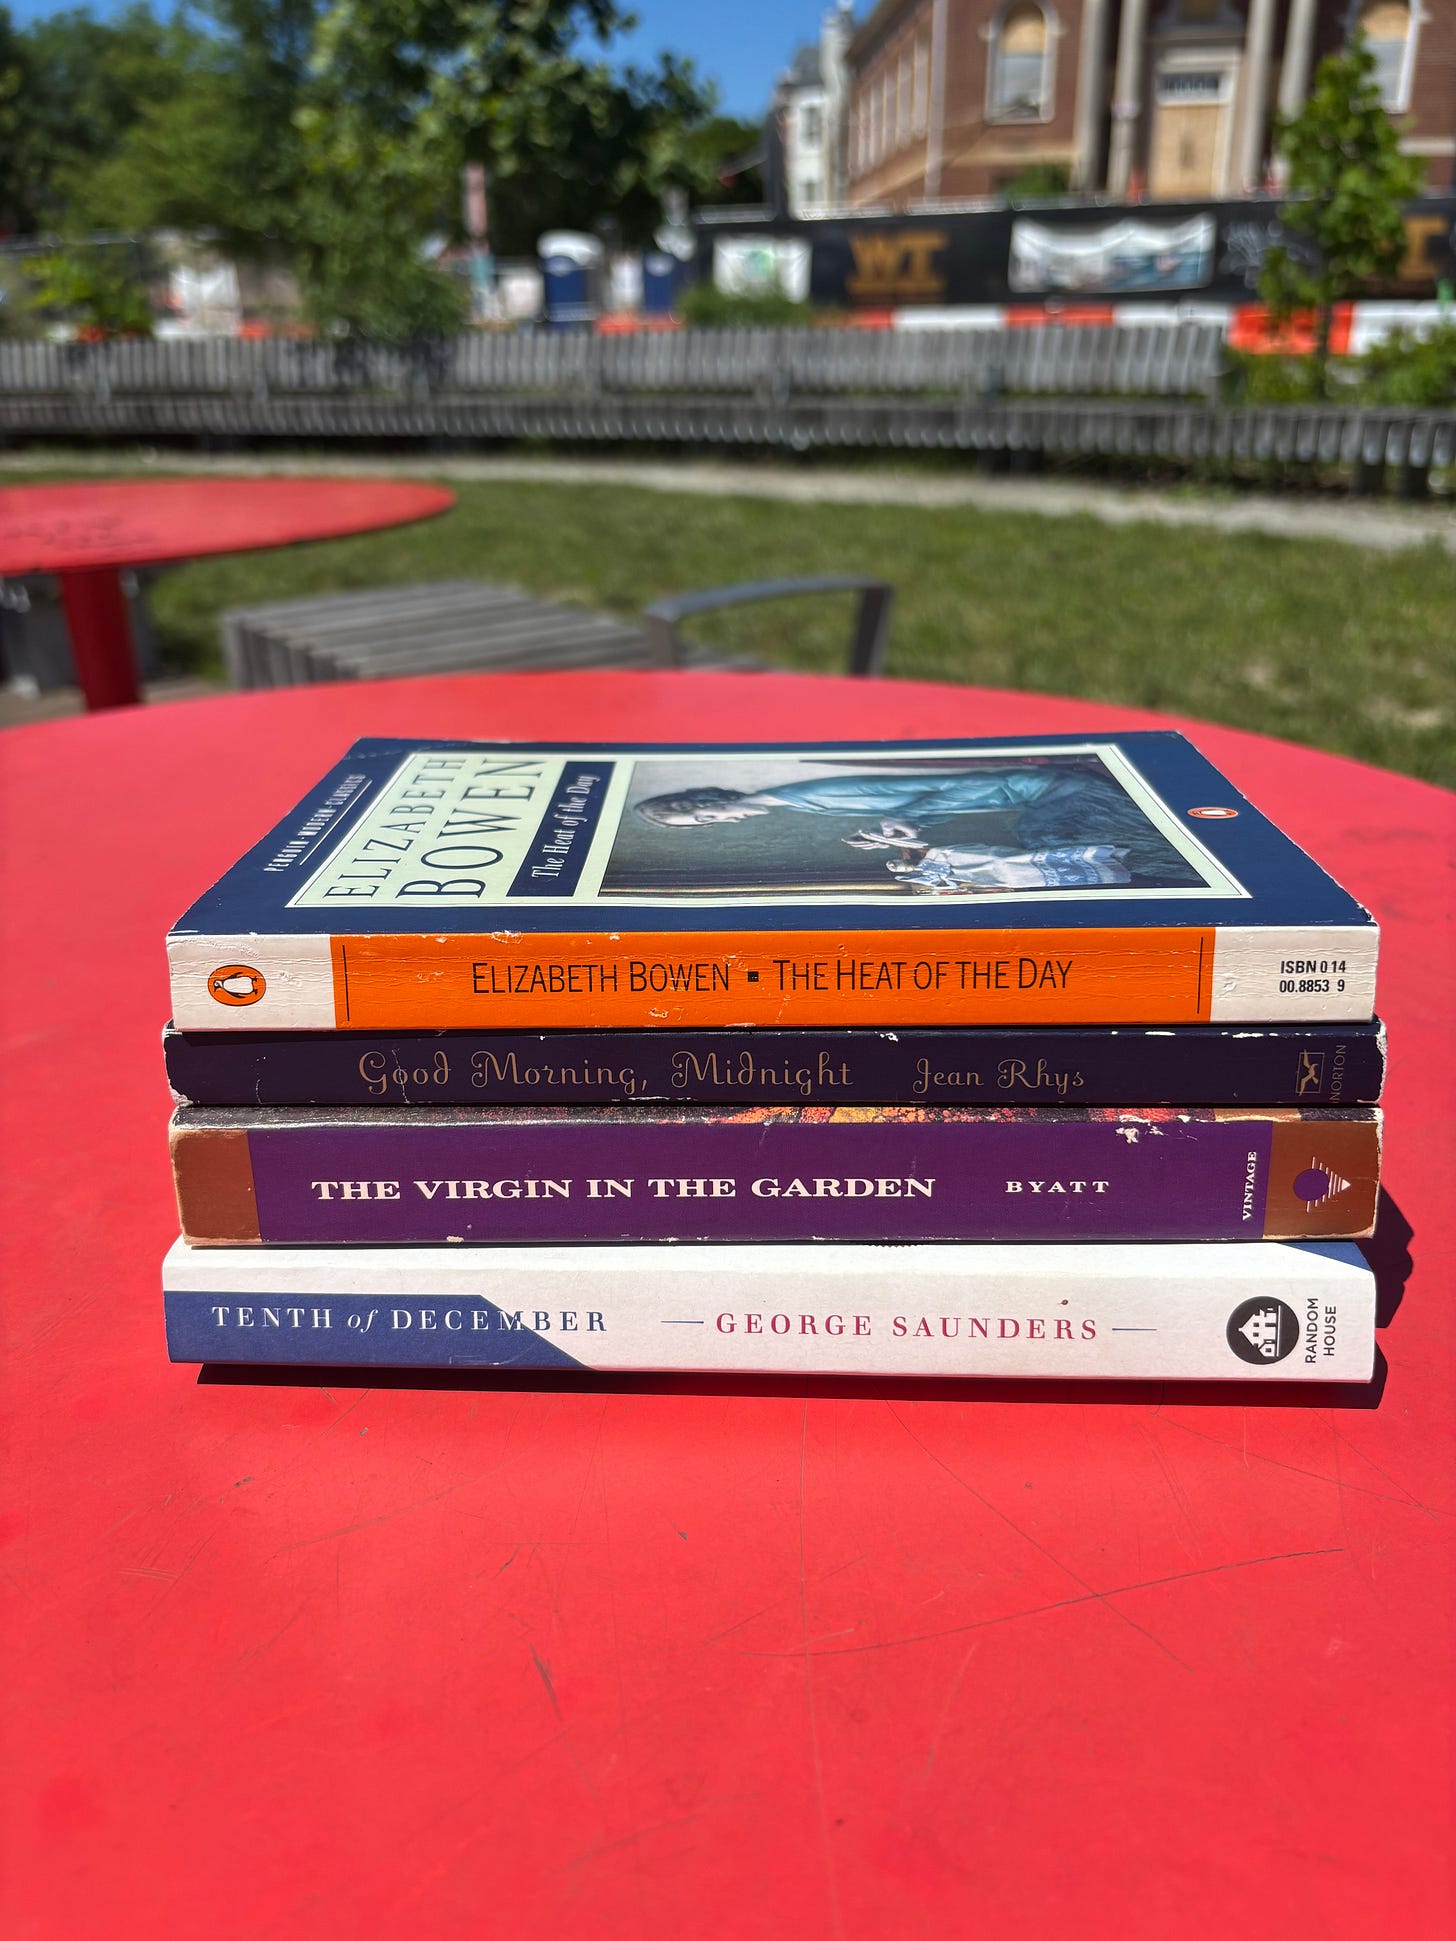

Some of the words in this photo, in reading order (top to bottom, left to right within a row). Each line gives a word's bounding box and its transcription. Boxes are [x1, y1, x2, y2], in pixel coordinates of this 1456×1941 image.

[566, 773, 601, 795] Day
[565, 791, 589, 814] the
[566, 810, 588, 827] of
[322, 758, 466, 898] ELIZABETH
[395, 758, 547, 899] BOWEN
[542, 820, 576, 854] Heat
[532, 847, 566, 878] The
[472, 962, 618, 994] ELIZABETH
[629, 961, 730, 993] BOWEN
[773, 959, 829, 991] THE
[837, 959, 907, 990] HEAT
[913, 961, 950, 990] OF
[955, 960, 1010, 990] THE
[1018, 957, 1073, 989] DAY
[1280, 960, 1317, 974] ISBN
[1279, 980, 1330, 993] 00.8853
[1337, 979, 1345, 992] 9
[358, 1050, 452, 1096] Good
[470, 1050, 648, 1095] Morning,
[671, 1050, 855, 1096] Midnight
[912, 1057, 984, 1094] Jean
[997, 1058, 1085, 1095] Rhys
[1329, 1044, 1347, 1103] NORTON
[311, 1181, 400, 1200] THE
[413, 1179, 573, 1199] VIRGIN
[586, 1179, 635, 1198] IN
[647, 1178, 737, 1198] THE
[751, 1178, 936, 1198] GARDEN
[1005, 1181, 1110, 1194] BYATT
[1242, 1151, 1257, 1221] VINTAGE
[211, 1306, 333, 1329] TENTH
[347, 1308, 380, 1334] of
[391, 1309, 608, 1332] DECEMBER
[716, 1312, 873, 1337] GEORGE
[892, 1315, 1098, 1341] SAUNDERS
[1305, 1298, 1319, 1364] RANDOM
[1323, 1306, 1337, 1357] HOUSE
